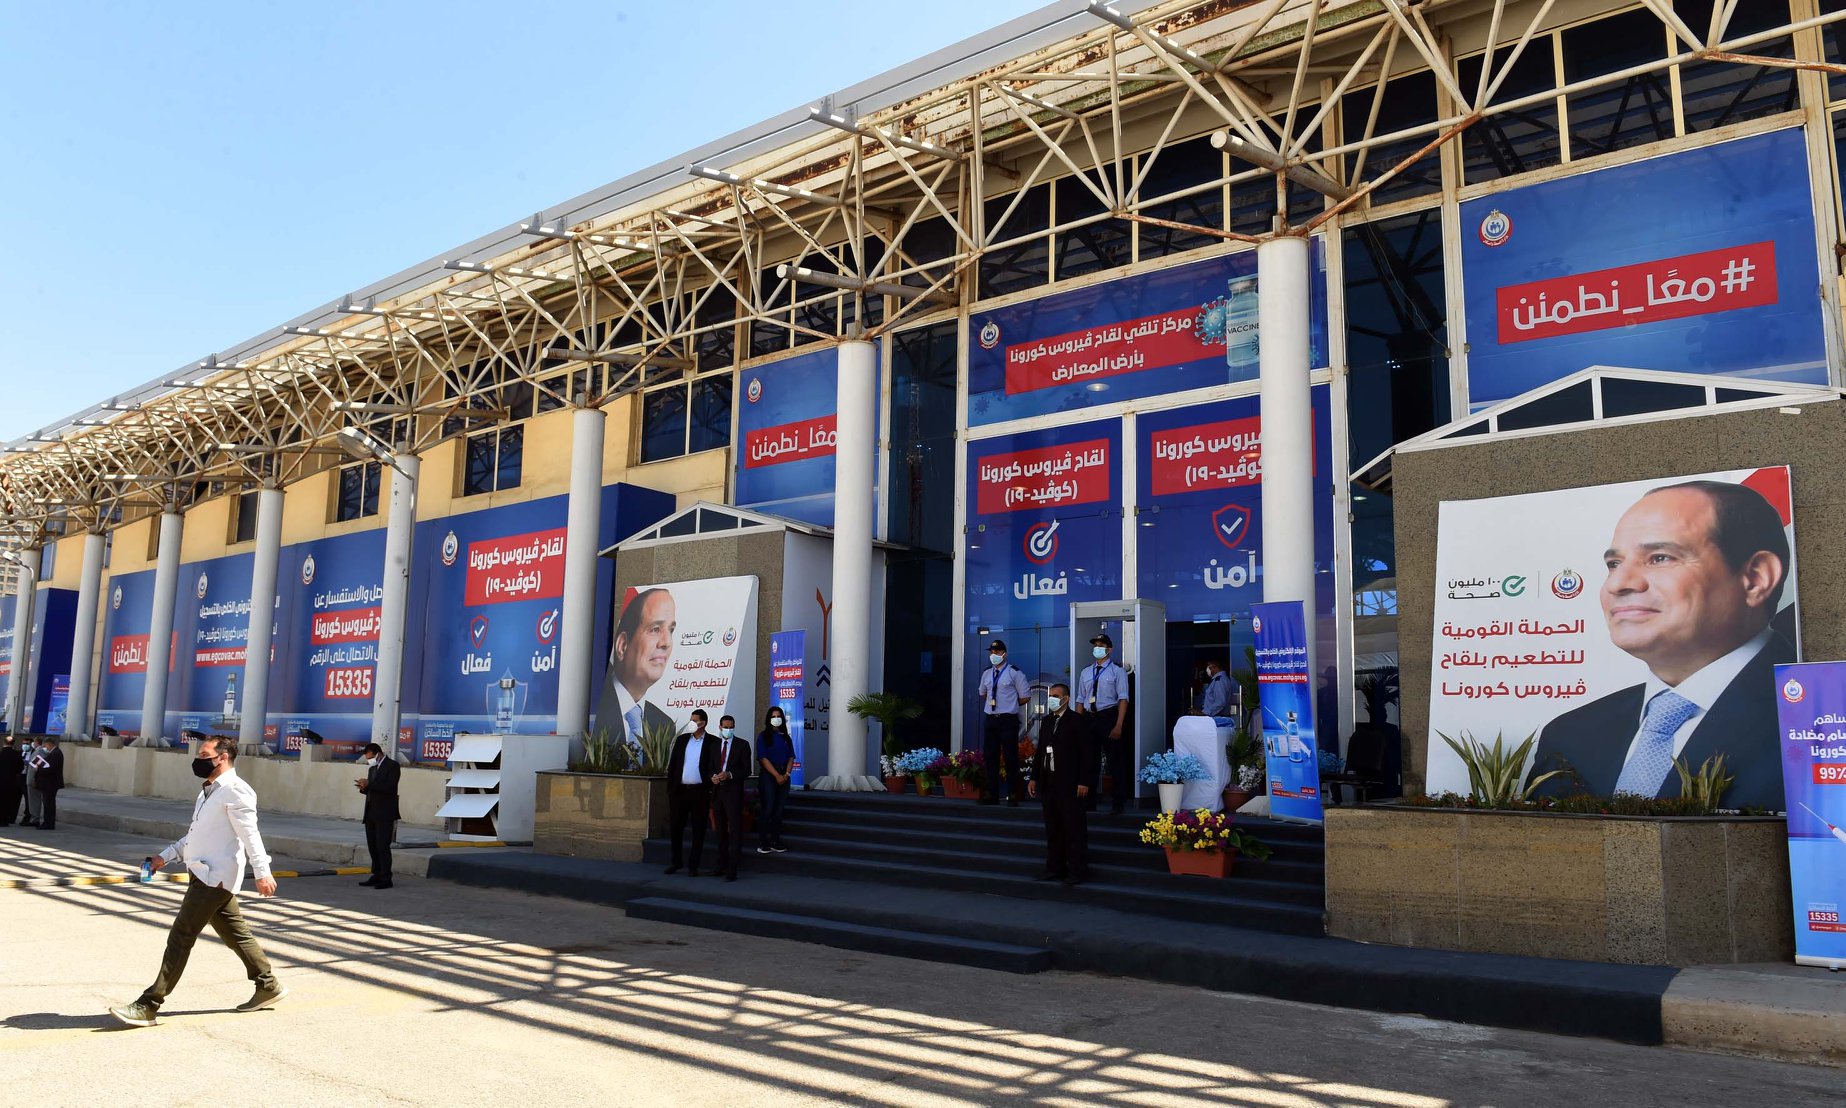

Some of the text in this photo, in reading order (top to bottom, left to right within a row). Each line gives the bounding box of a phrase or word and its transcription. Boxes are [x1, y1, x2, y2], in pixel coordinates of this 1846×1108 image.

[1095, 327, 1122, 347] لقاح
[1124, 320, 1159, 344] تلقي
[1161, 316, 1192, 337] مركز
[1010, 343, 1047, 364] كورونا
[1051, 350, 1144, 381] بأرض المعارض
[1155, 436, 1205, 461] كورونا
[1074, 448, 1105, 473] لقاح
[981, 460, 1021, 484] كورونا
[470, 547, 500, 571] كورونا
[540, 536, 564, 562] لقاح
[1203, 550, 1256, 590] آمن
[1013, 571, 1068, 600] فعال
[1448, 577, 1485, 589] مليون
[314, 593, 324, 608] عن
[324, 584, 368, 609] والاستفسار
[1448, 590, 1501, 600] صحة
[315, 616, 340, 639] كورونا
[681, 631, 697, 639] مليون
[1442, 618, 1585, 640] الحملة القومية
[310, 648, 329, 667] الرقم
[330, 648, 345, 664] على
[346, 644, 373, 663] الاتصال
[461, 651, 492, 675] فعال
[531, 645, 557, 673] آمن
[1440, 649, 1585, 669] للتطعيم بلقاح
[674, 658, 732, 672] الحملة القومية
[327, 669, 372, 696] 15335
[669, 677, 728, 690] للتطعيم بلقاح
[780, 688, 796, 698] 15335
[1442, 678, 1587, 699] ڤيروس كورونا
[666, 697, 694, 709] كورونا
[1788, 729, 1826, 741] مضادة
[423, 742, 452, 758] 15335
[1809, 912, 1838, 922] 15335
